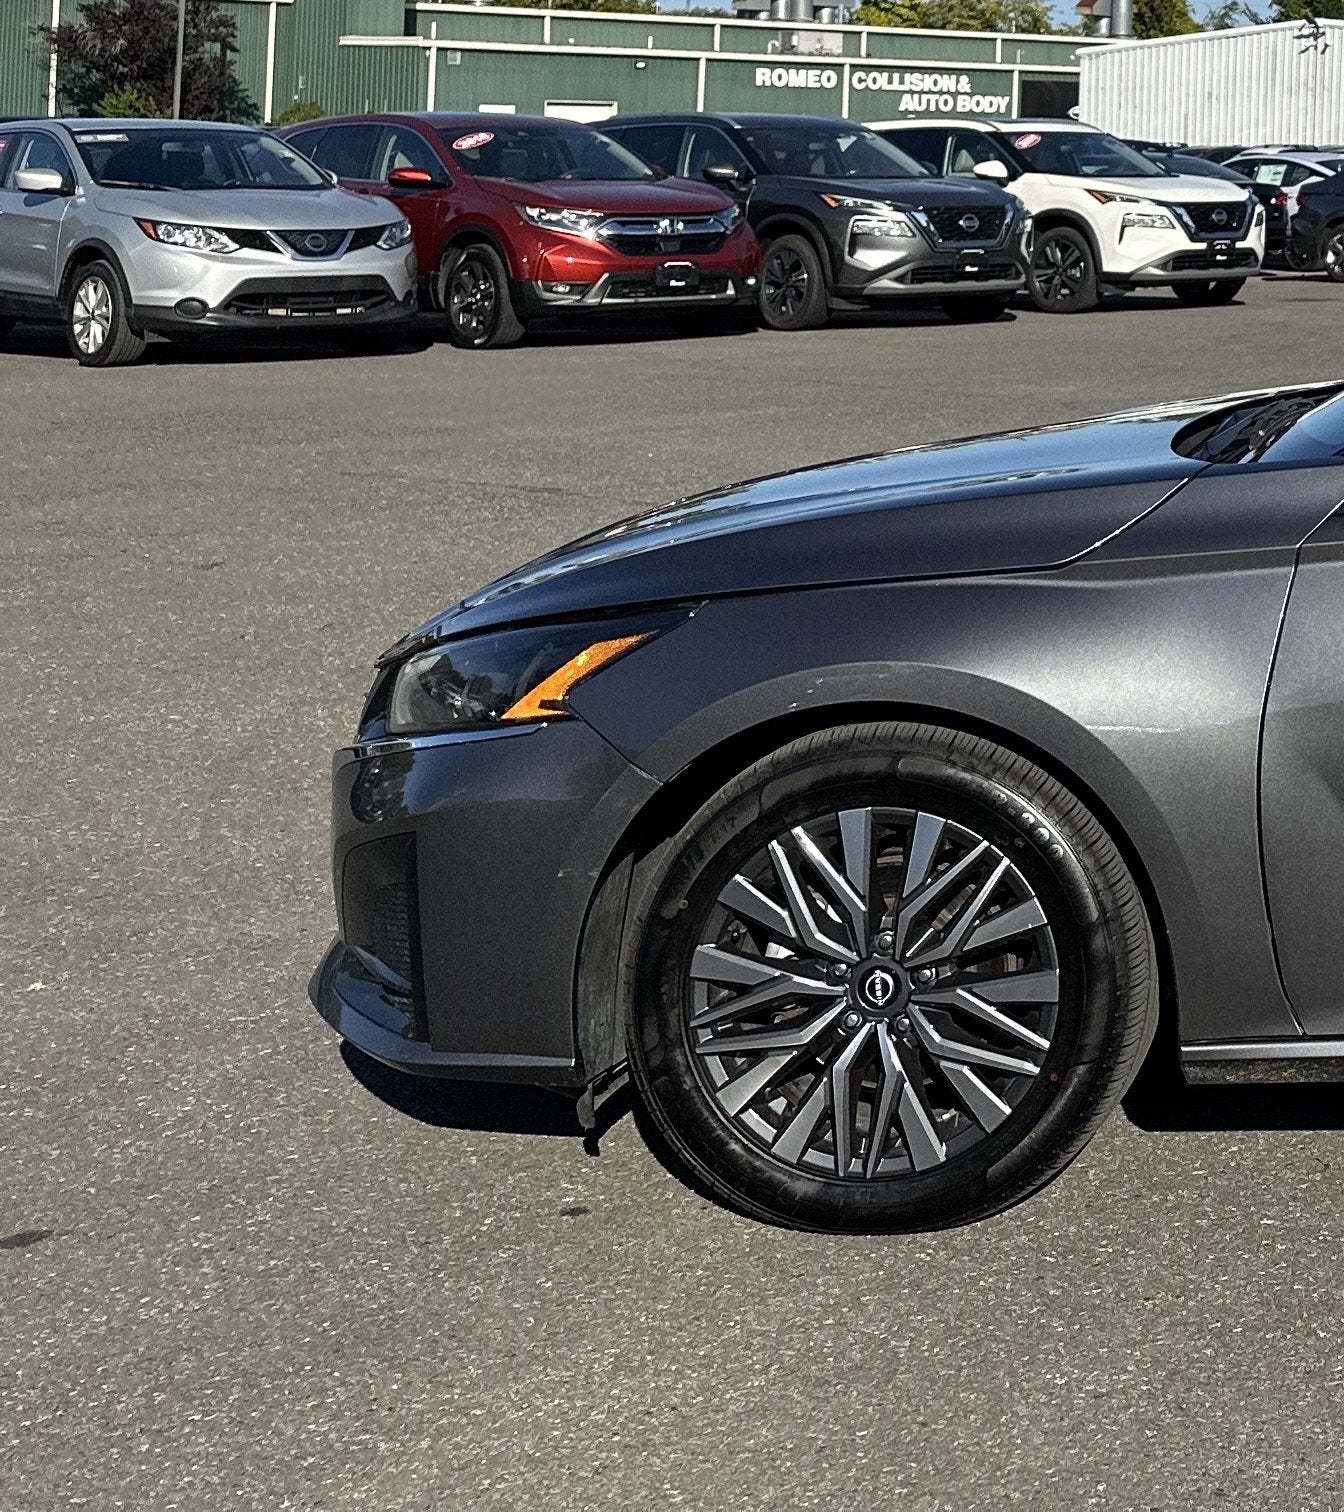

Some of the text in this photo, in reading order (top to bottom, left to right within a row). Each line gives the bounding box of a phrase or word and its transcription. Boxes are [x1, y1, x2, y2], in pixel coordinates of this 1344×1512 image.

[755, 67, 838, 89] ROMEO
[899, 93, 1010, 114] AUTO BODY
